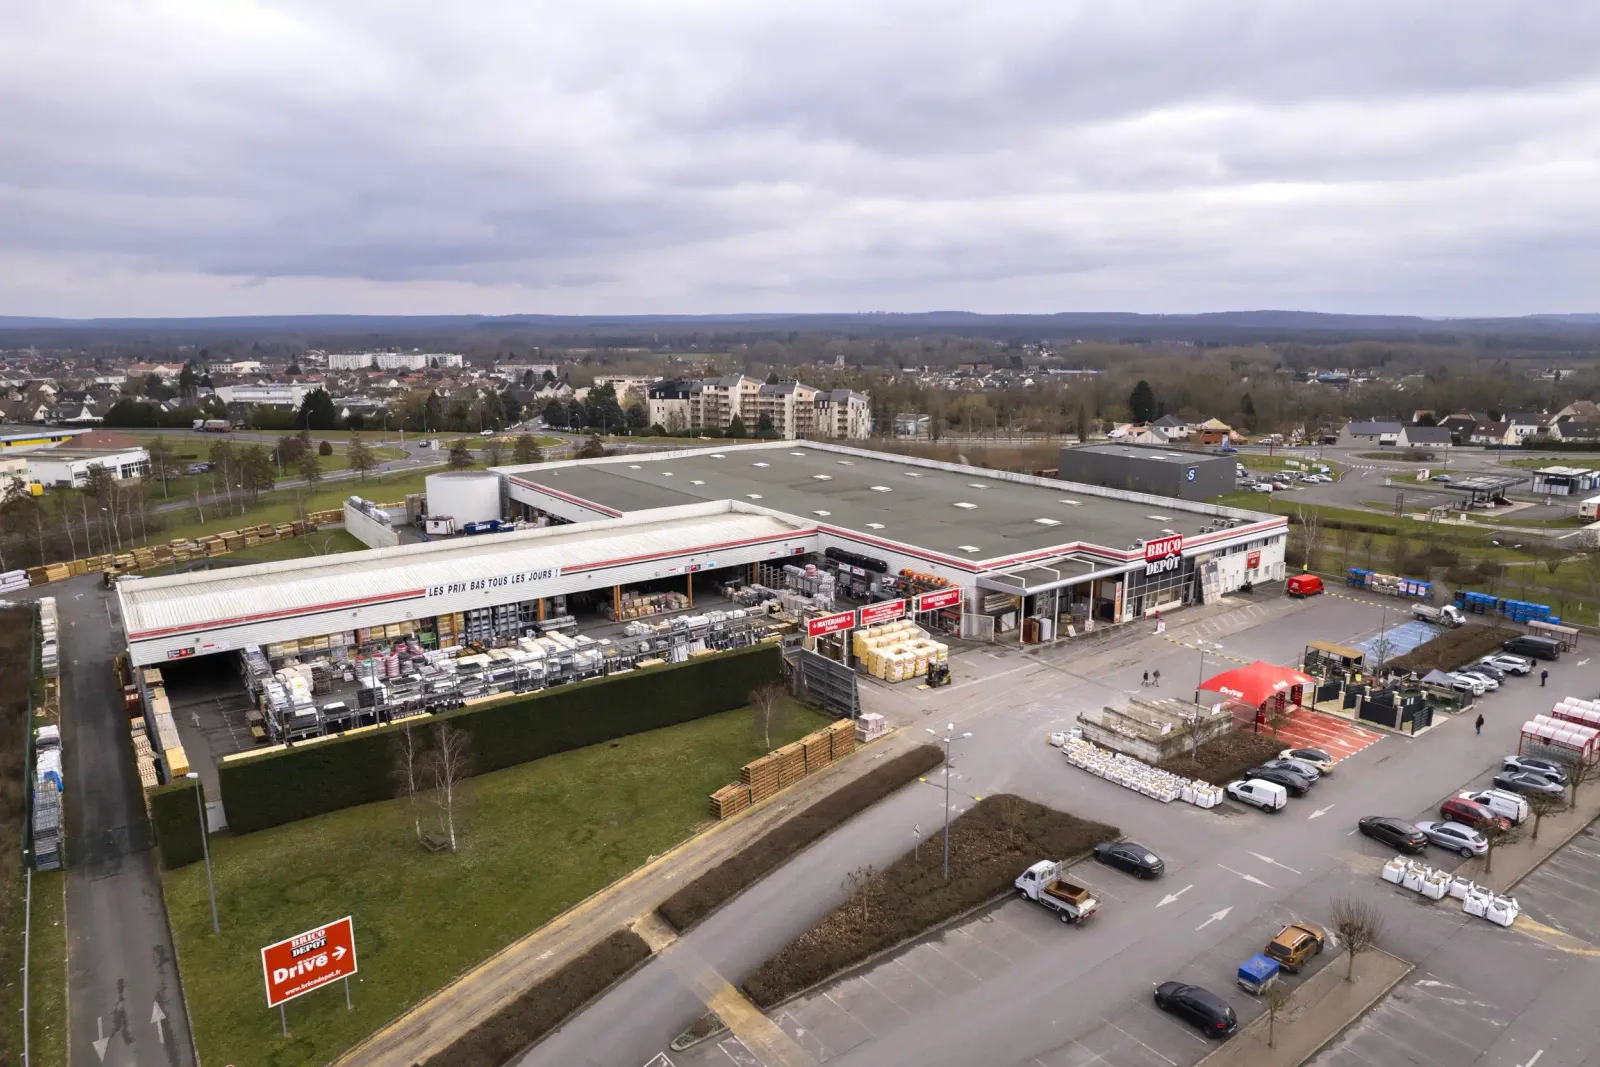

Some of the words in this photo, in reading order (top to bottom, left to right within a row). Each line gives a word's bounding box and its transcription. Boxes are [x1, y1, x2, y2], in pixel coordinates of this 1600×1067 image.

[1147, 538, 1182, 558] BRICO
[1145, 553, 1181, 576] DEPÔT
[429, 586, 444, 597] LES
[447, 582, 467, 594] PRIX
[470, 579, 486, 591] BAS
[488, 576, 508, 588] TOUS
[511, 573, 525, 584] LES
[528, 569, 552, 581] JOURS
[1219, 686, 1244, 698] Drive
[291, 928, 326, 948] BRICO
[273, 954, 329, 985] Drive
[285, 968, 342, 996] www.bricodepot.fr
